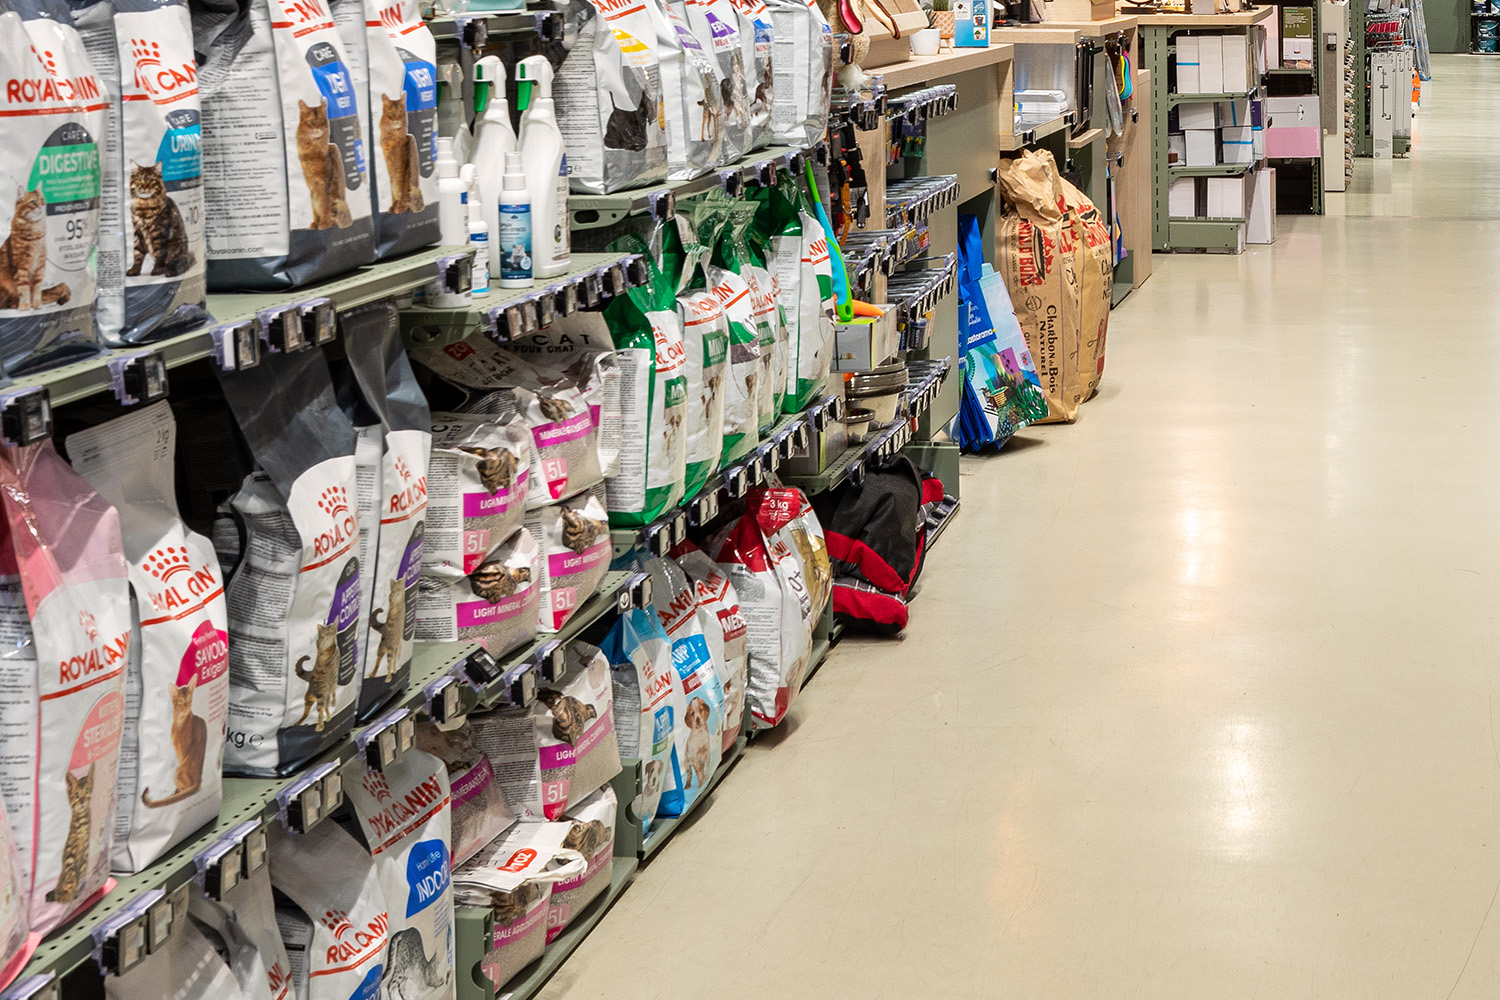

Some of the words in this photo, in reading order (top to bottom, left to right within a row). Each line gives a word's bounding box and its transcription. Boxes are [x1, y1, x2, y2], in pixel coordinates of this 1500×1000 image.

[314, 46, 333, 60] CARE
[7, 79, 56, 103] ROYAL
[62, 131, 81, 141] CARE
[39, 152, 98, 175] DIGESTIVE
[548, 462, 567, 479] 5L
[468, 535, 487, 551] 5L
[564, 557, 581, 568] LIGHT
[556, 592, 574, 609] 5L
[474, 608, 496, 618] LIGHT
[60, 648, 103, 684] ROYAL
[227, 728, 245, 748] kg
[548, 785, 567, 801] 5L
[548, 908, 567, 925] 5L
